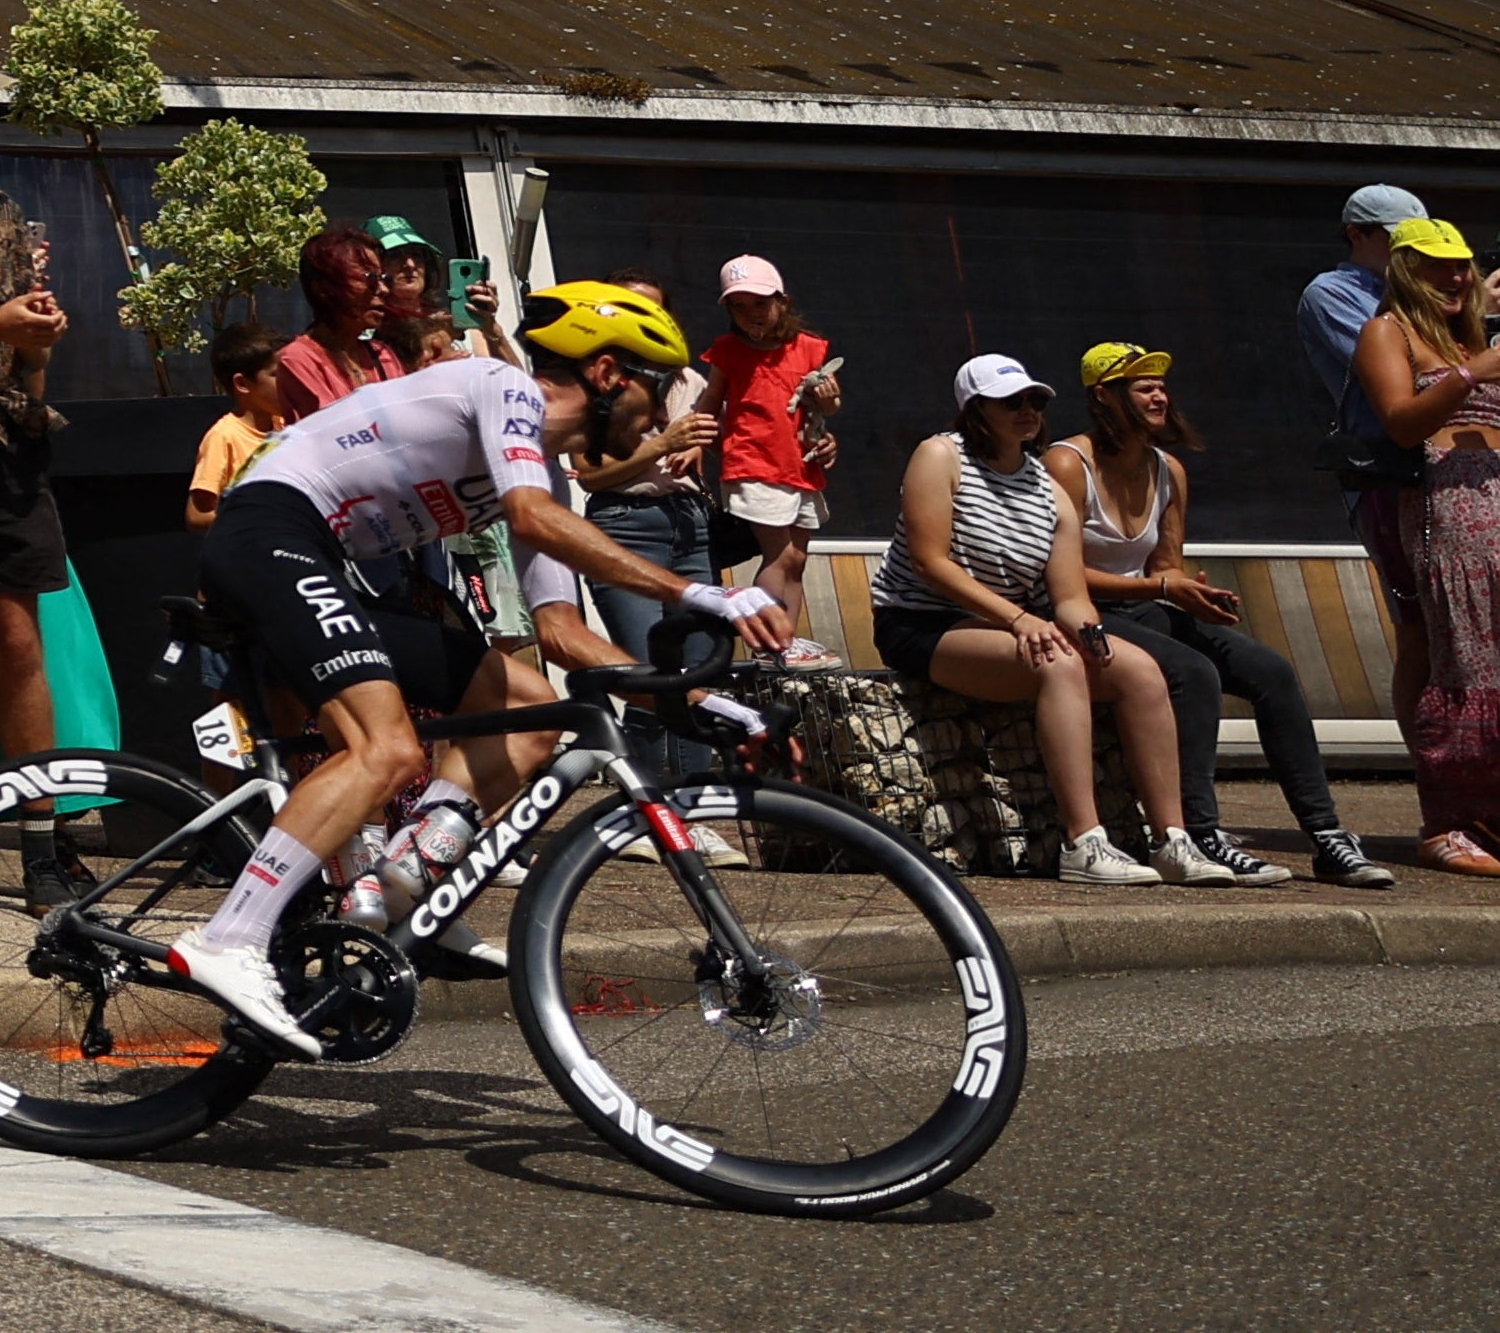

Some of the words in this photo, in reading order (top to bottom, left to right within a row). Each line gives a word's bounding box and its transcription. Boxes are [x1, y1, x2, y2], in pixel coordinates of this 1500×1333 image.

[295, 576, 361, 639] UAE
[195, 717, 231, 749] 18
[254, 849, 290, 876] UAE
[410, 775, 563, 938] COLNAGO
[953, 956, 1007, 1099] ENVE
[570, 1060, 715, 1172] ENVE
